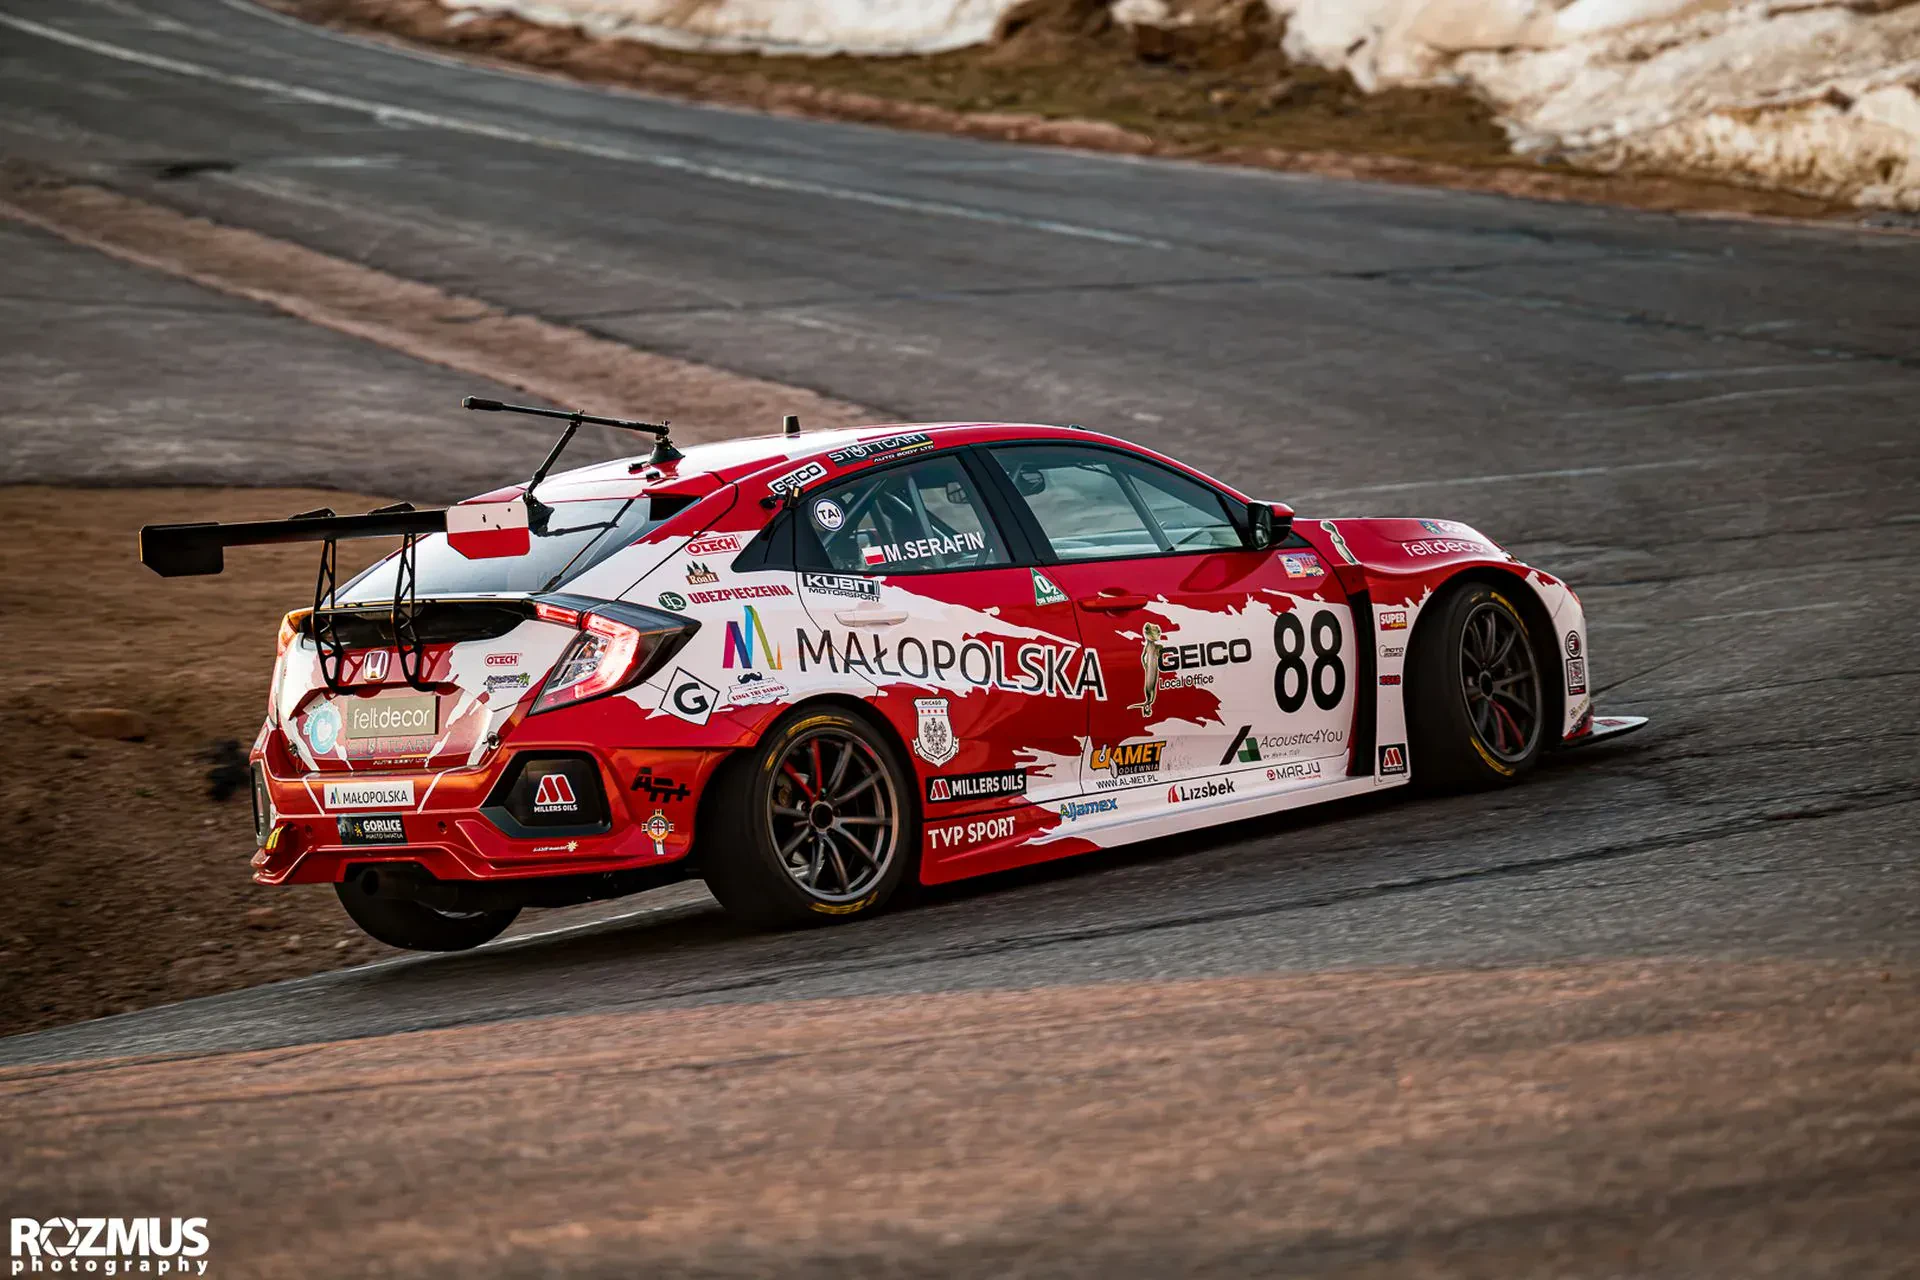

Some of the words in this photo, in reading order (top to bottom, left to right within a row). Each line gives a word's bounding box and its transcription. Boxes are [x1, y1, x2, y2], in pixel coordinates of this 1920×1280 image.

[828, 433, 927, 462] STUTTGART
[874, 454, 896, 463] AUTO
[897, 448, 918, 459] BODY
[920, 445, 935, 453] LTD
[771, 464, 822, 493] GEICO
[818, 508, 840, 520] TAI
[883, 532, 985, 563] M.SERAFIN
[805, 574, 873, 593] KUBIT
[687, 585, 794, 604] UBEZPIECZENIA
[808, 587, 881, 603] MOTORSPORT
[1380, 613, 1406, 625] SUPER
[796, 628, 1106, 699] MAŁOPOLSKA
[1158, 638, 1252, 672] GEICO
[1274, 610, 1346, 714] 88
[1159, 675, 1184, 690] Local
[1185, 673, 1215, 687] Office
[673, 682, 710, 715] G
[353, 706, 430, 730] feltdecor
[1259, 728, 1344, 750] Acoustic4You
[1118, 763, 1160, 775] ODLEWNIA
[1276, 762, 1321, 779] MARJU
[952, 776, 1000, 797] MILLERS
[1001, 774, 1024, 791] OILS
[1096, 774, 1159, 789] WWW.AL-MET.PL
[343, 789, 408, 805] MAŁOPOLSKA
[533, 805, 562, 813] MILLERS
[562, 804, 578, 812] OILS
[363, 819, 402, 831] GORLICE
[927, 826, 964, 849] TVP
[967, 816, 1015, 843] SPORT
